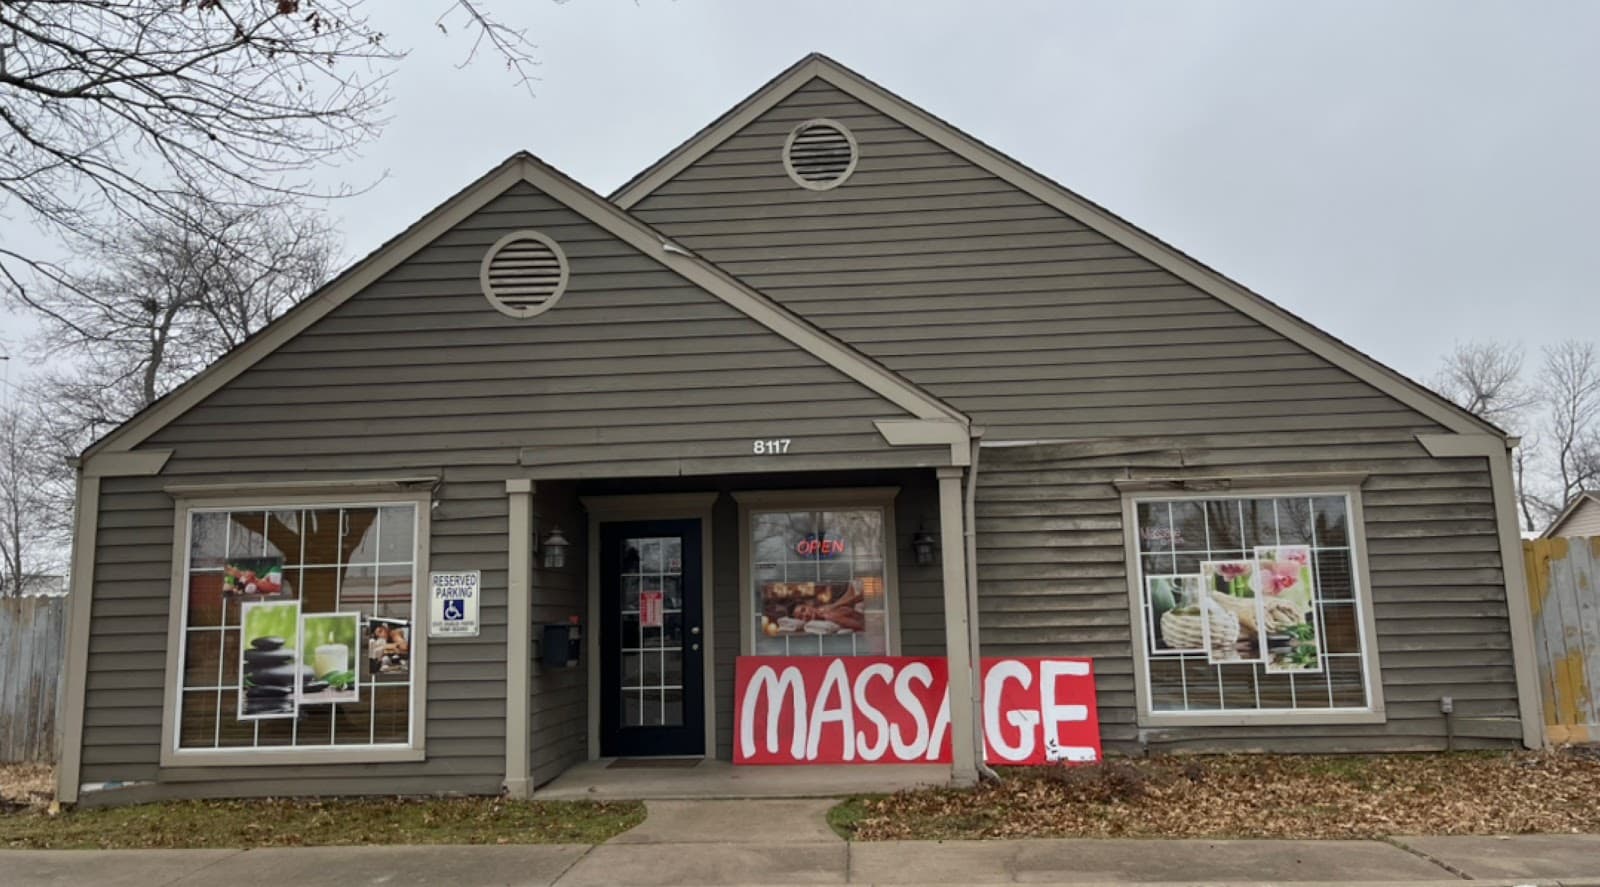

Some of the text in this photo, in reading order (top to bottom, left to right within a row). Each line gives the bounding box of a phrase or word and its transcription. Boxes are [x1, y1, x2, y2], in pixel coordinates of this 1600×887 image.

[753, 439, 791, 454] 8117
[797, 539, 845, 554] OPEN
[433, 574, 476, 586] RESERVED
[435, 587, 473, 599] PARKING
